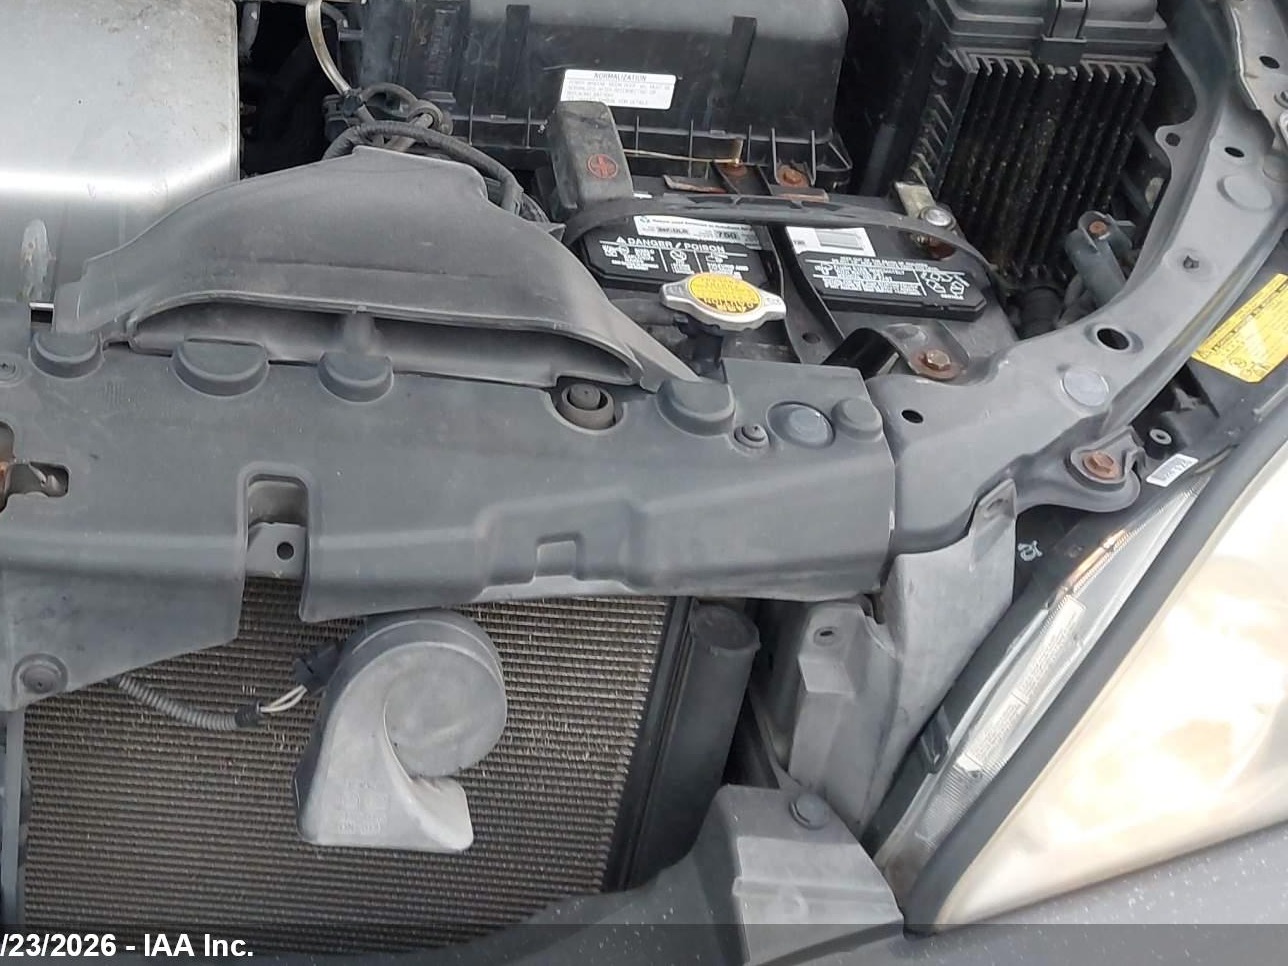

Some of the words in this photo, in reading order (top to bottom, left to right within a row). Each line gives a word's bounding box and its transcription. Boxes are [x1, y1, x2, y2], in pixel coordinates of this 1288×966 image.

[593, 72, 648, 82] NORMALIZATION
[627, 237, 673, 249] DANGER
[683, 242, 725, 253] POISON
